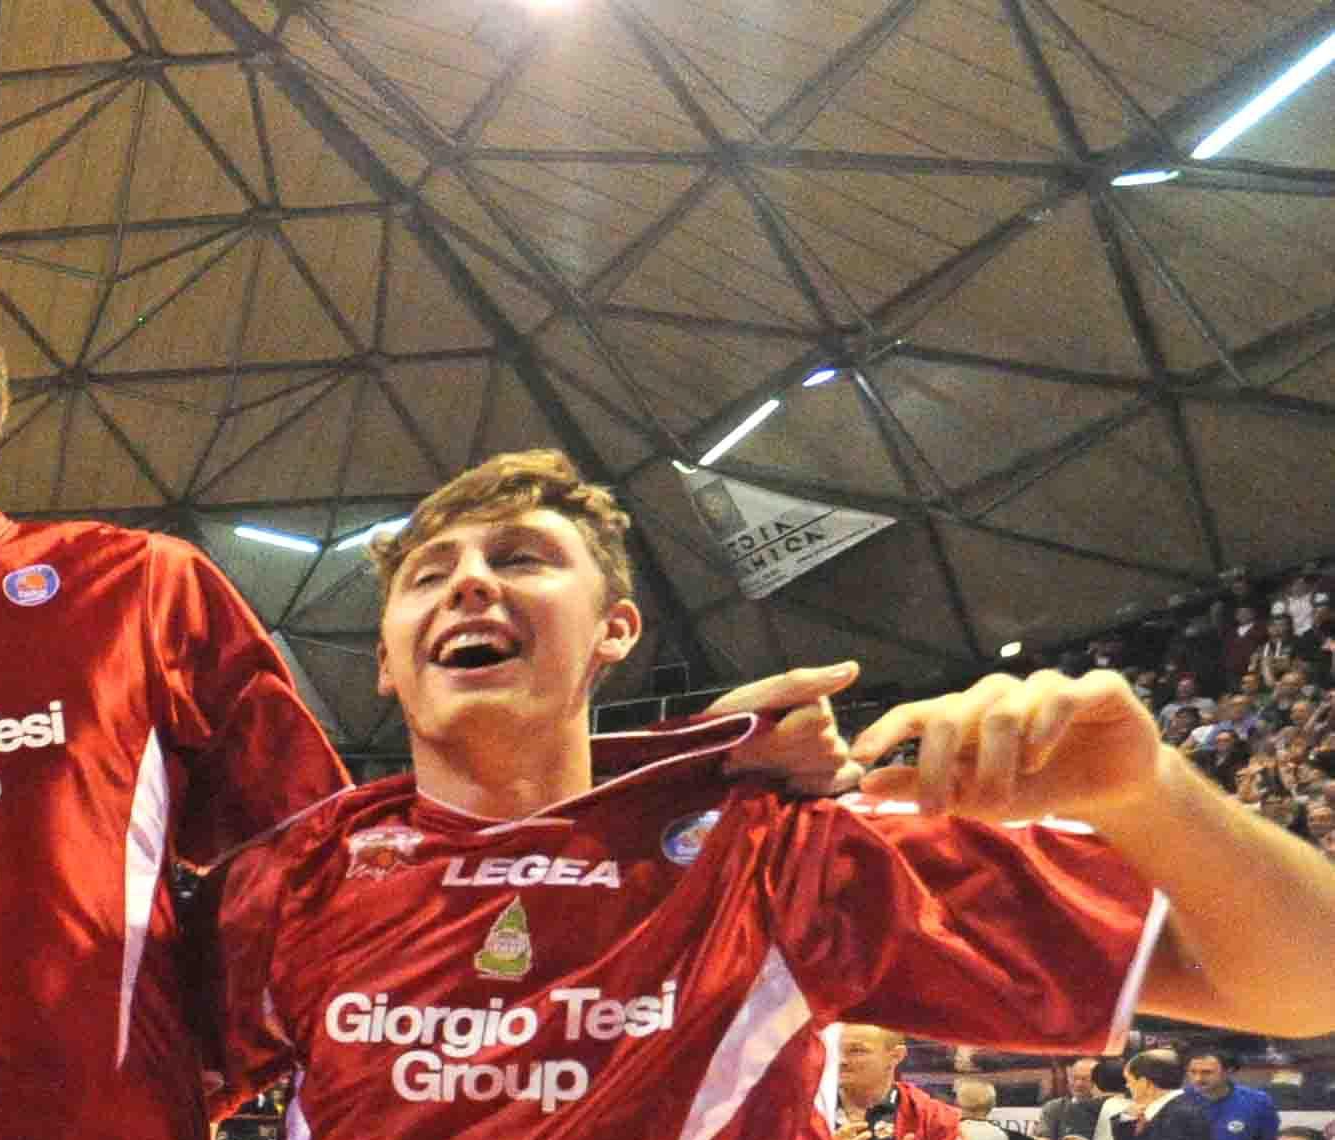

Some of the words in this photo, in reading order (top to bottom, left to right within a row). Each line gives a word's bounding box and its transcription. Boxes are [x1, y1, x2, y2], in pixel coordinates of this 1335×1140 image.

[441, 854, 621, 889] LEGEA
[324, 992, 539, 1059] Giorgio
[548, 980, 679, 1041] Tesi
[391, 1049, 591, 1113] Group
